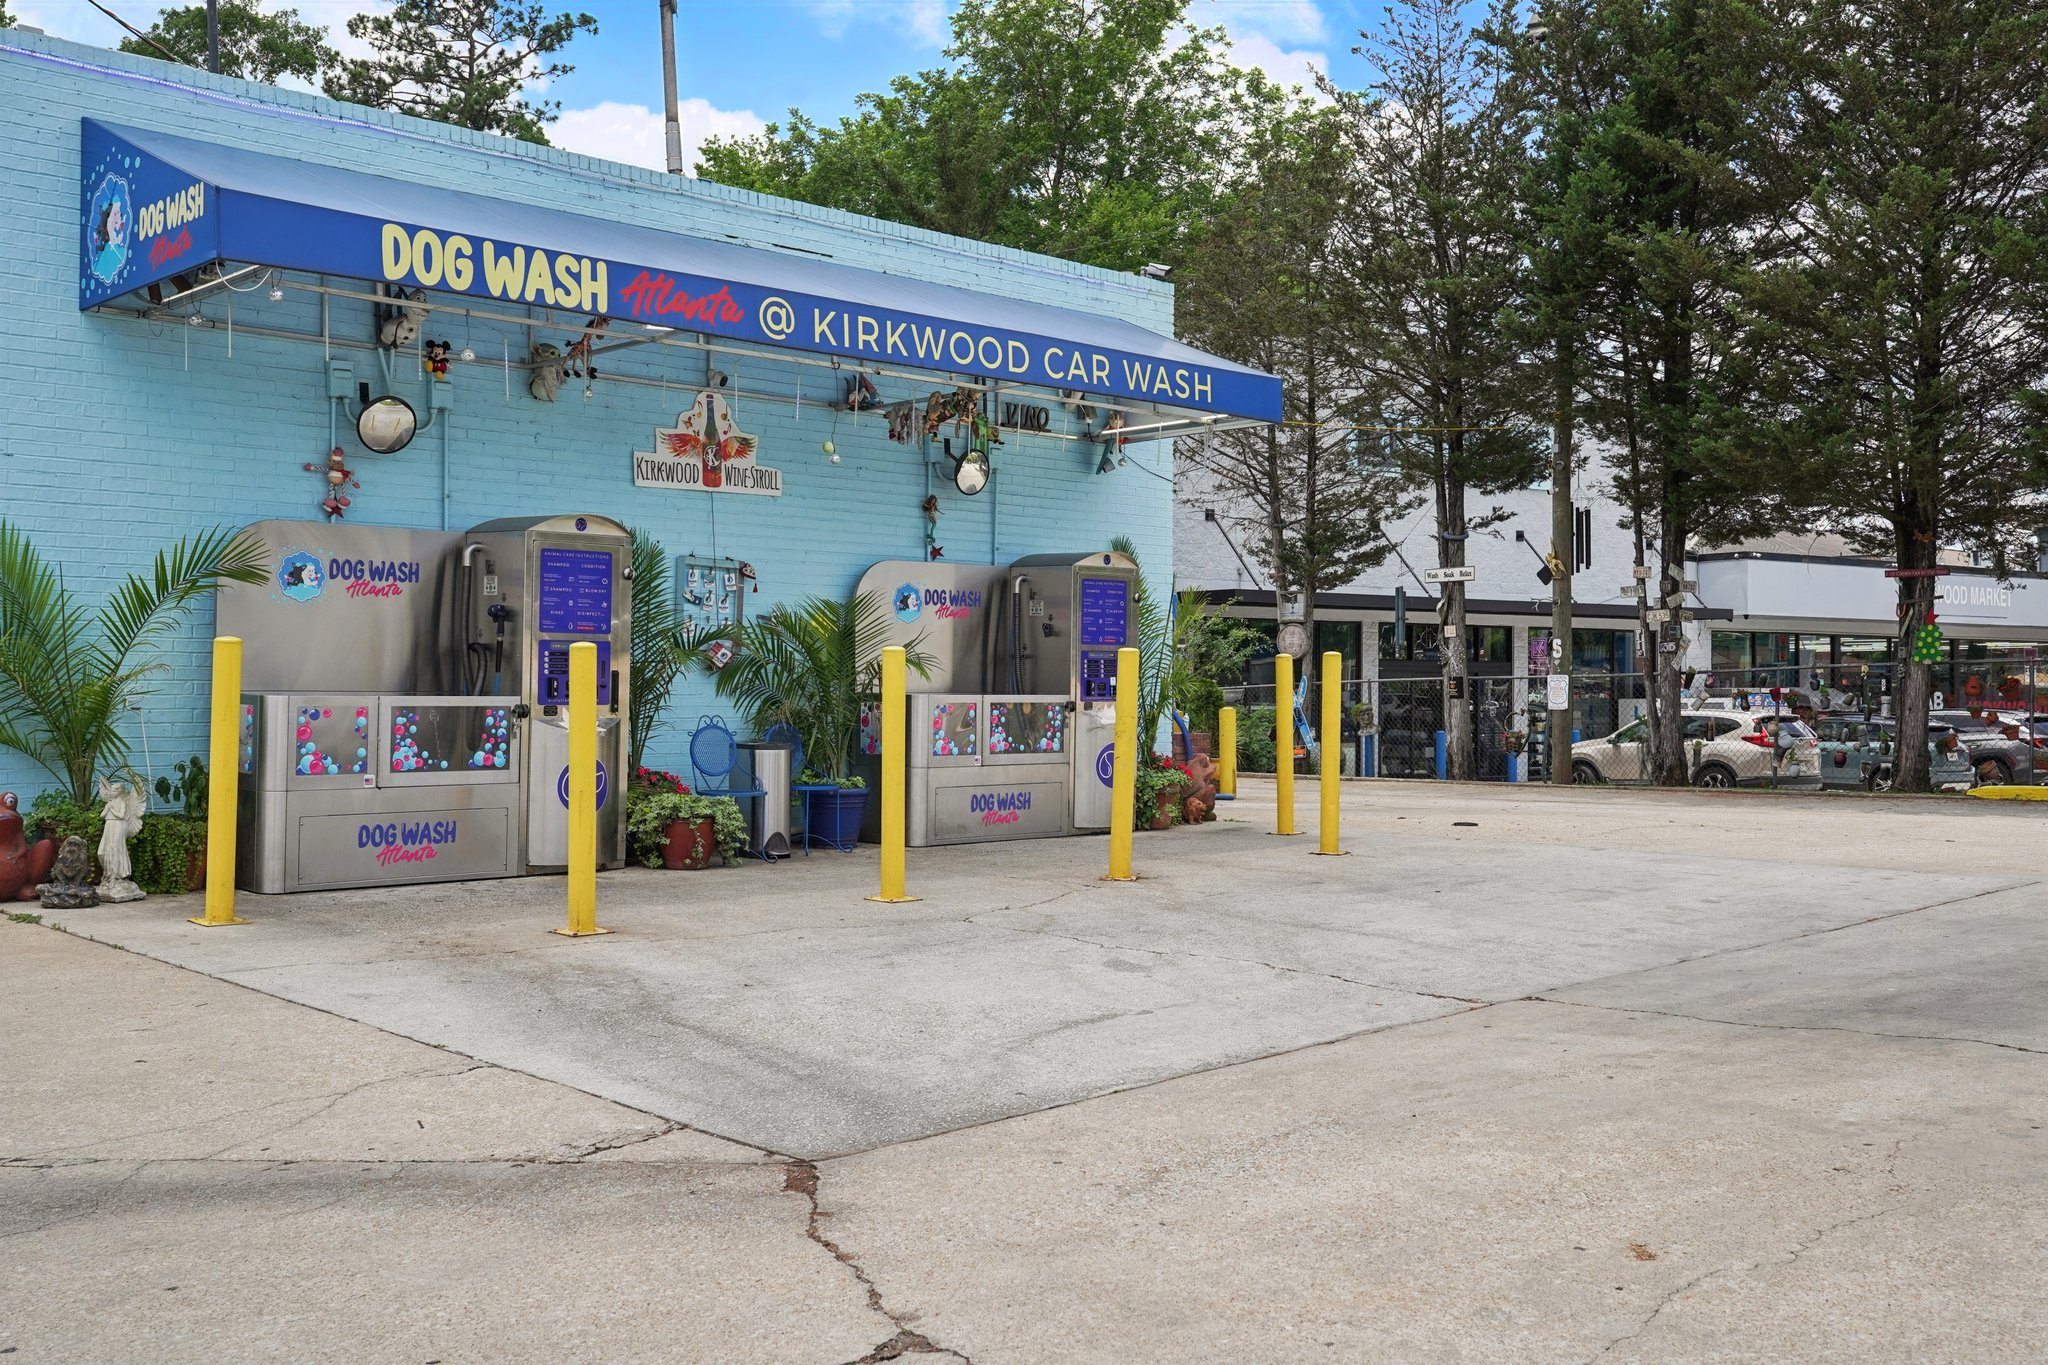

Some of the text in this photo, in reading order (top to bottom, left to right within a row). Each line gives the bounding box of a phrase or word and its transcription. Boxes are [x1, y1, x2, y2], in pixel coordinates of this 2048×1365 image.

[139, 182, 204, 241] DOG WASH
[381, 222, 1213, 403] DOG WASH Atlanta @ KIRKWOOD CAR WASH
[1005, 402, 1050, 430] VINO
[724, 464, 780, 490] WINE-STROLL
[330, 558, 420, 584] DOG WASH
[345, 578, 402, 599] Atlanta
[925, 588, 982, 608] DOG WASH
[1934, 584, 2012, 607] WOOD MARKET
[935, 604, 970, 620] Atlanta
[1552, 638, 1562, 658] S
[971, 792, 1031, 812] DOG WASH
[982, 807, 1020, 826] Atlanta
[358, 820, 456, 848] DOG WASH
[376, 842, 438, 867] Atlanta
